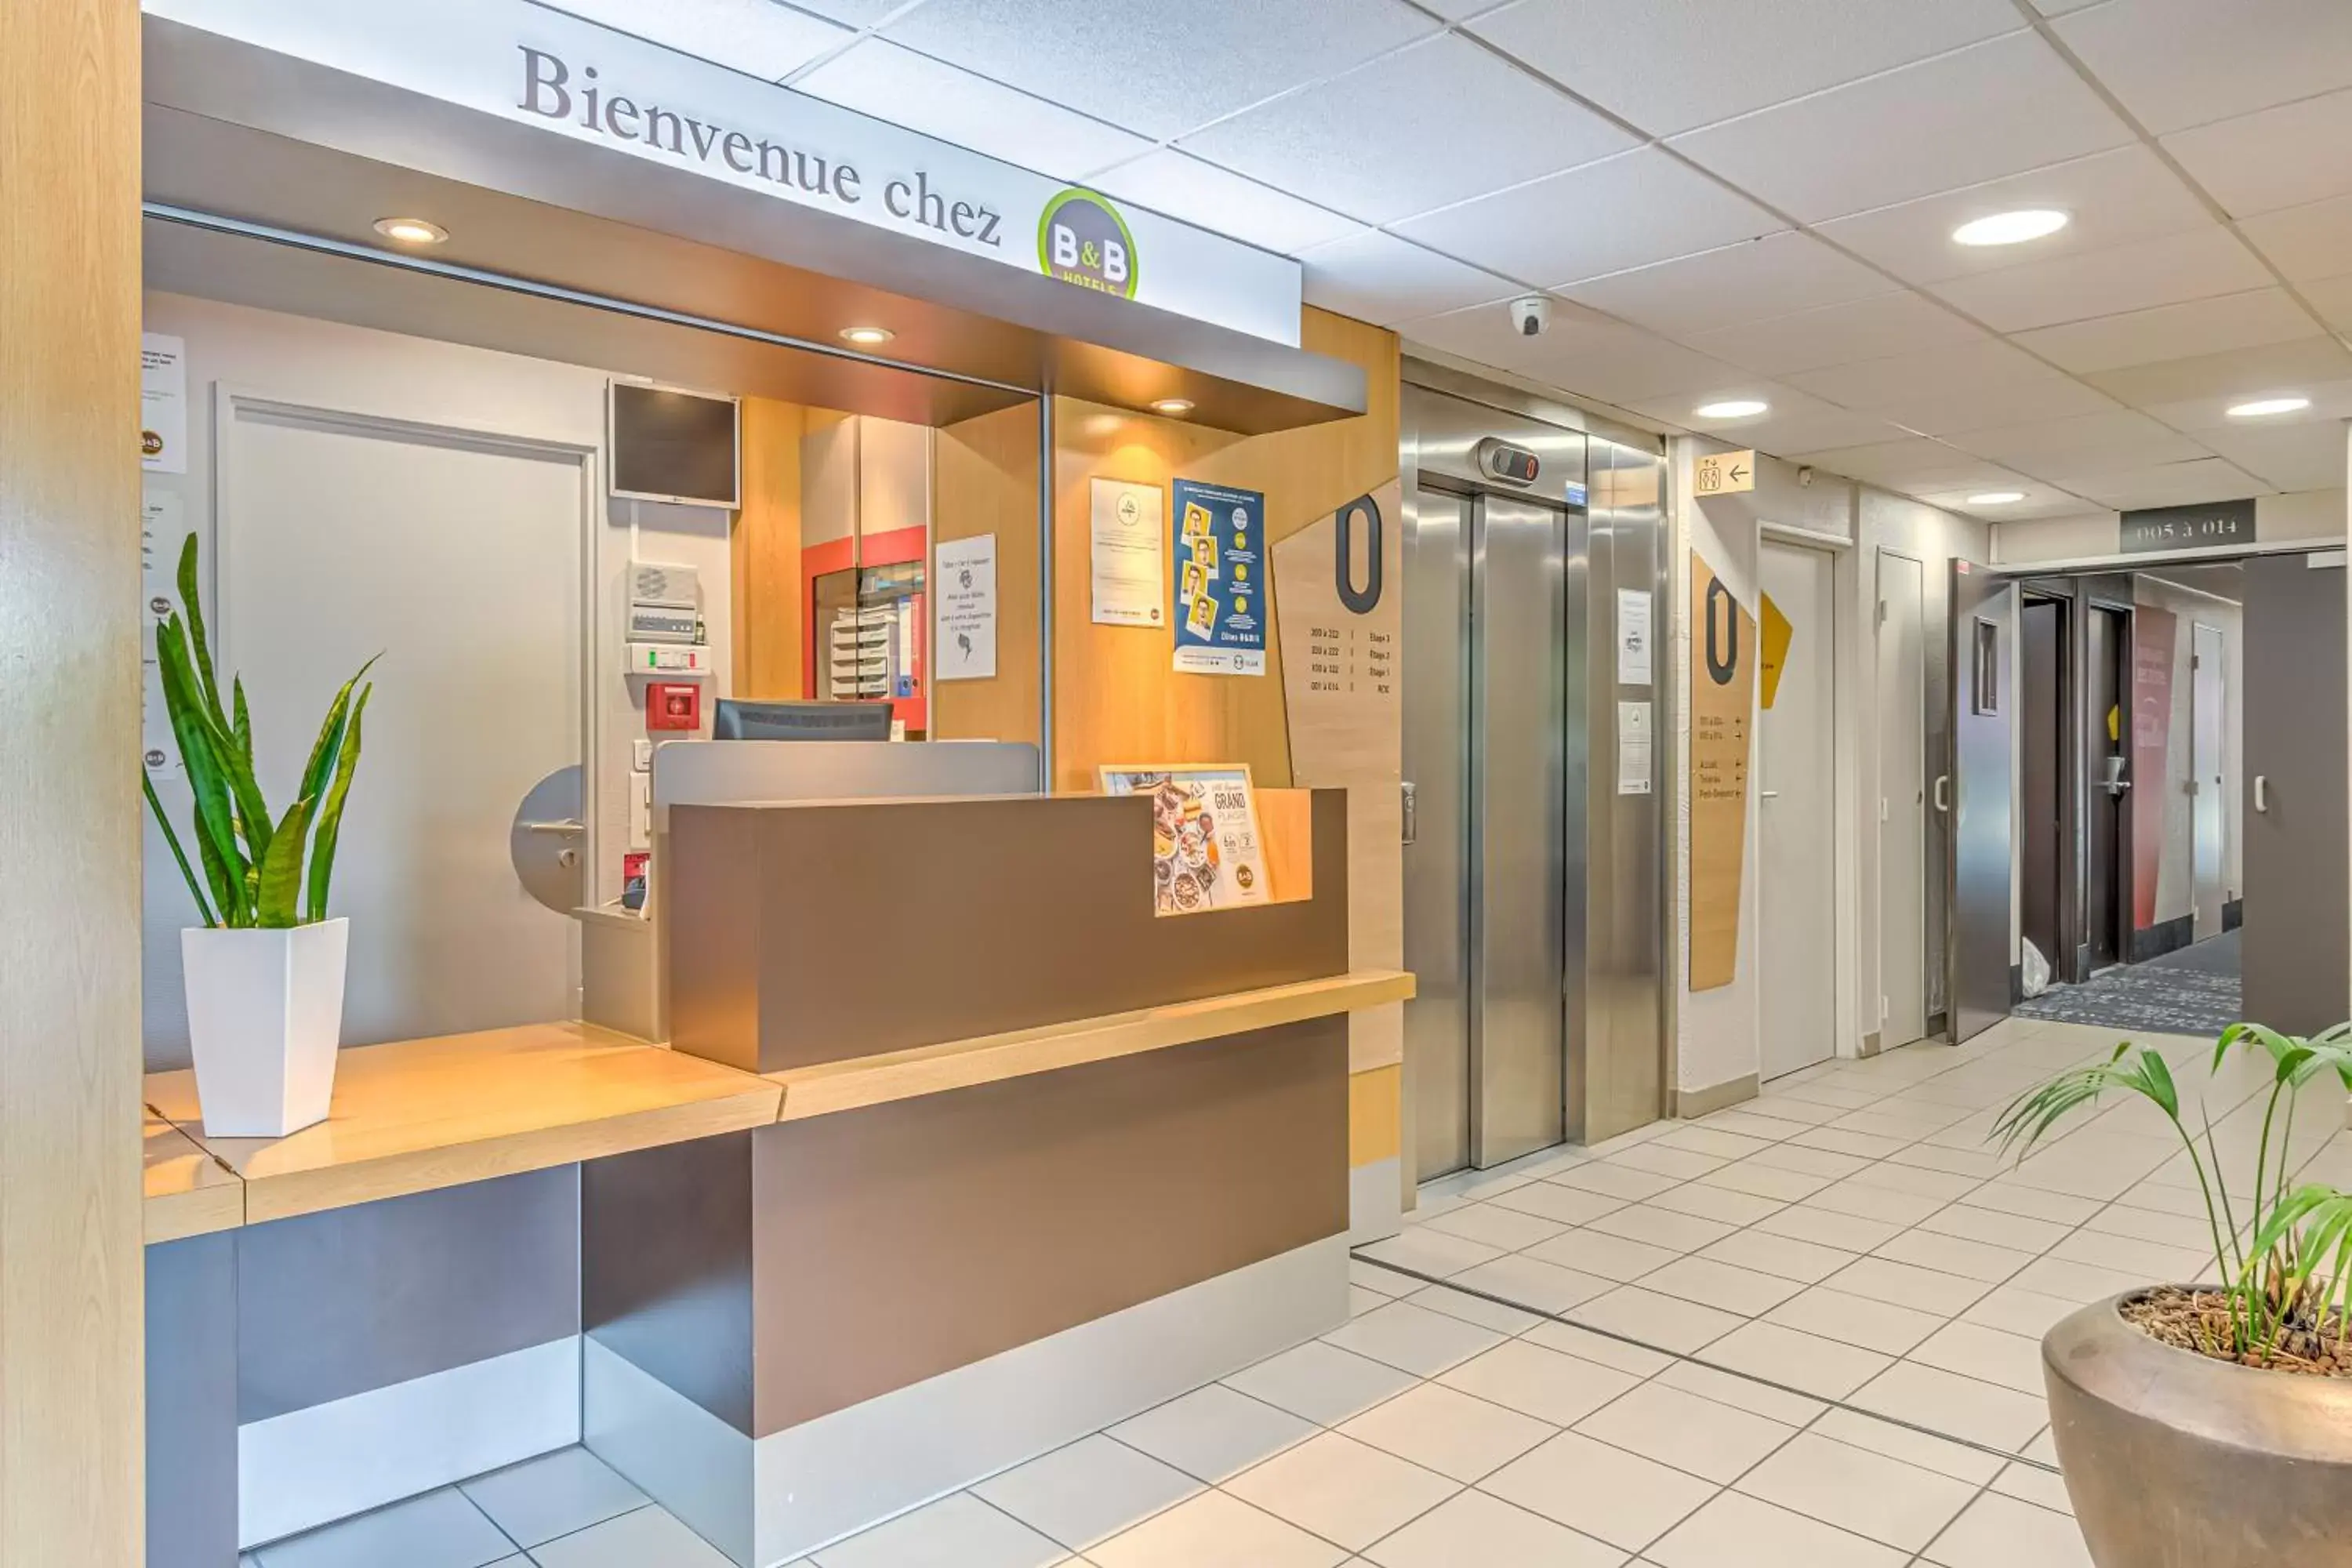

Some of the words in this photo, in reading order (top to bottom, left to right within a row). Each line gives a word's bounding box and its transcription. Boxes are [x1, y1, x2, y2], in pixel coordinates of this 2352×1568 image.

[517, 45, 860, 203] Bienvenue
[884, 172, 1001, 247] chez
[1054, 223, 1127, 282] B&B
[1526, 459, 1536, 479] 0
[1336, 494, 1381, 614] 0
[2136, 522, 2174, 540] 005
[2183, 521, 2193, 537] à
[2202, 515, 2238, 535] 014
[1707, 575, 1737, 685] 0
[1214, 793, 1246, 810] GRAND
